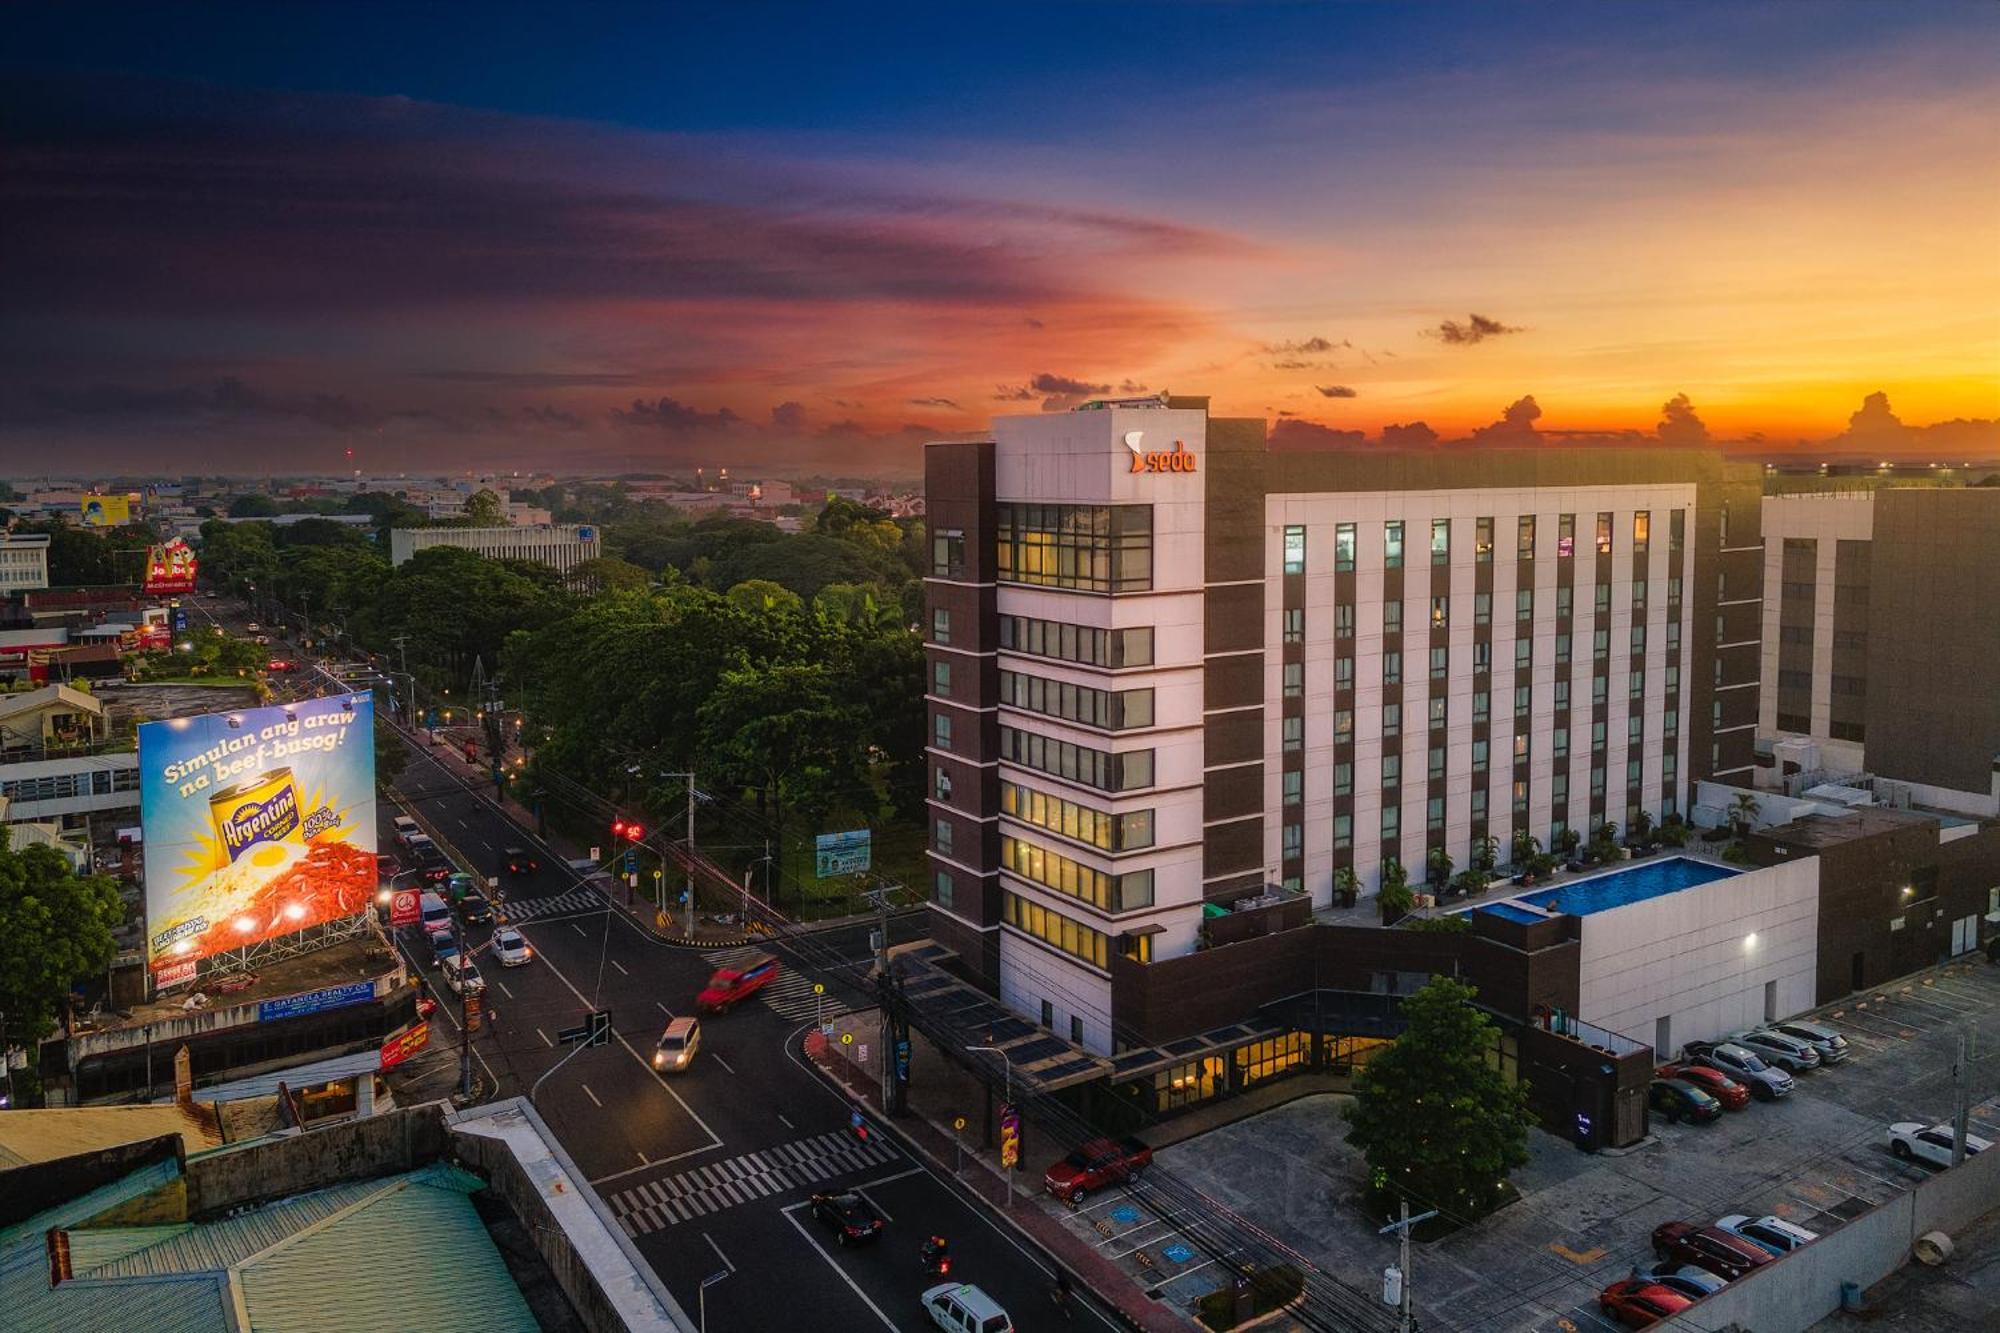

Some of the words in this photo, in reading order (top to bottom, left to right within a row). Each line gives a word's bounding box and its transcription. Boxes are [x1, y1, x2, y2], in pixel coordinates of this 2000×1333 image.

[1146, 440, 1196, 473] seda
[164, 739, 256, 784] Simulan
[261, 720, 300, 740] ang
[304, 711, 357, 728] araw
[179, 775, 211, 798] na
[212, 726, 346, 783] beef-busog!
[223, 792, 294, 847] Argentina
